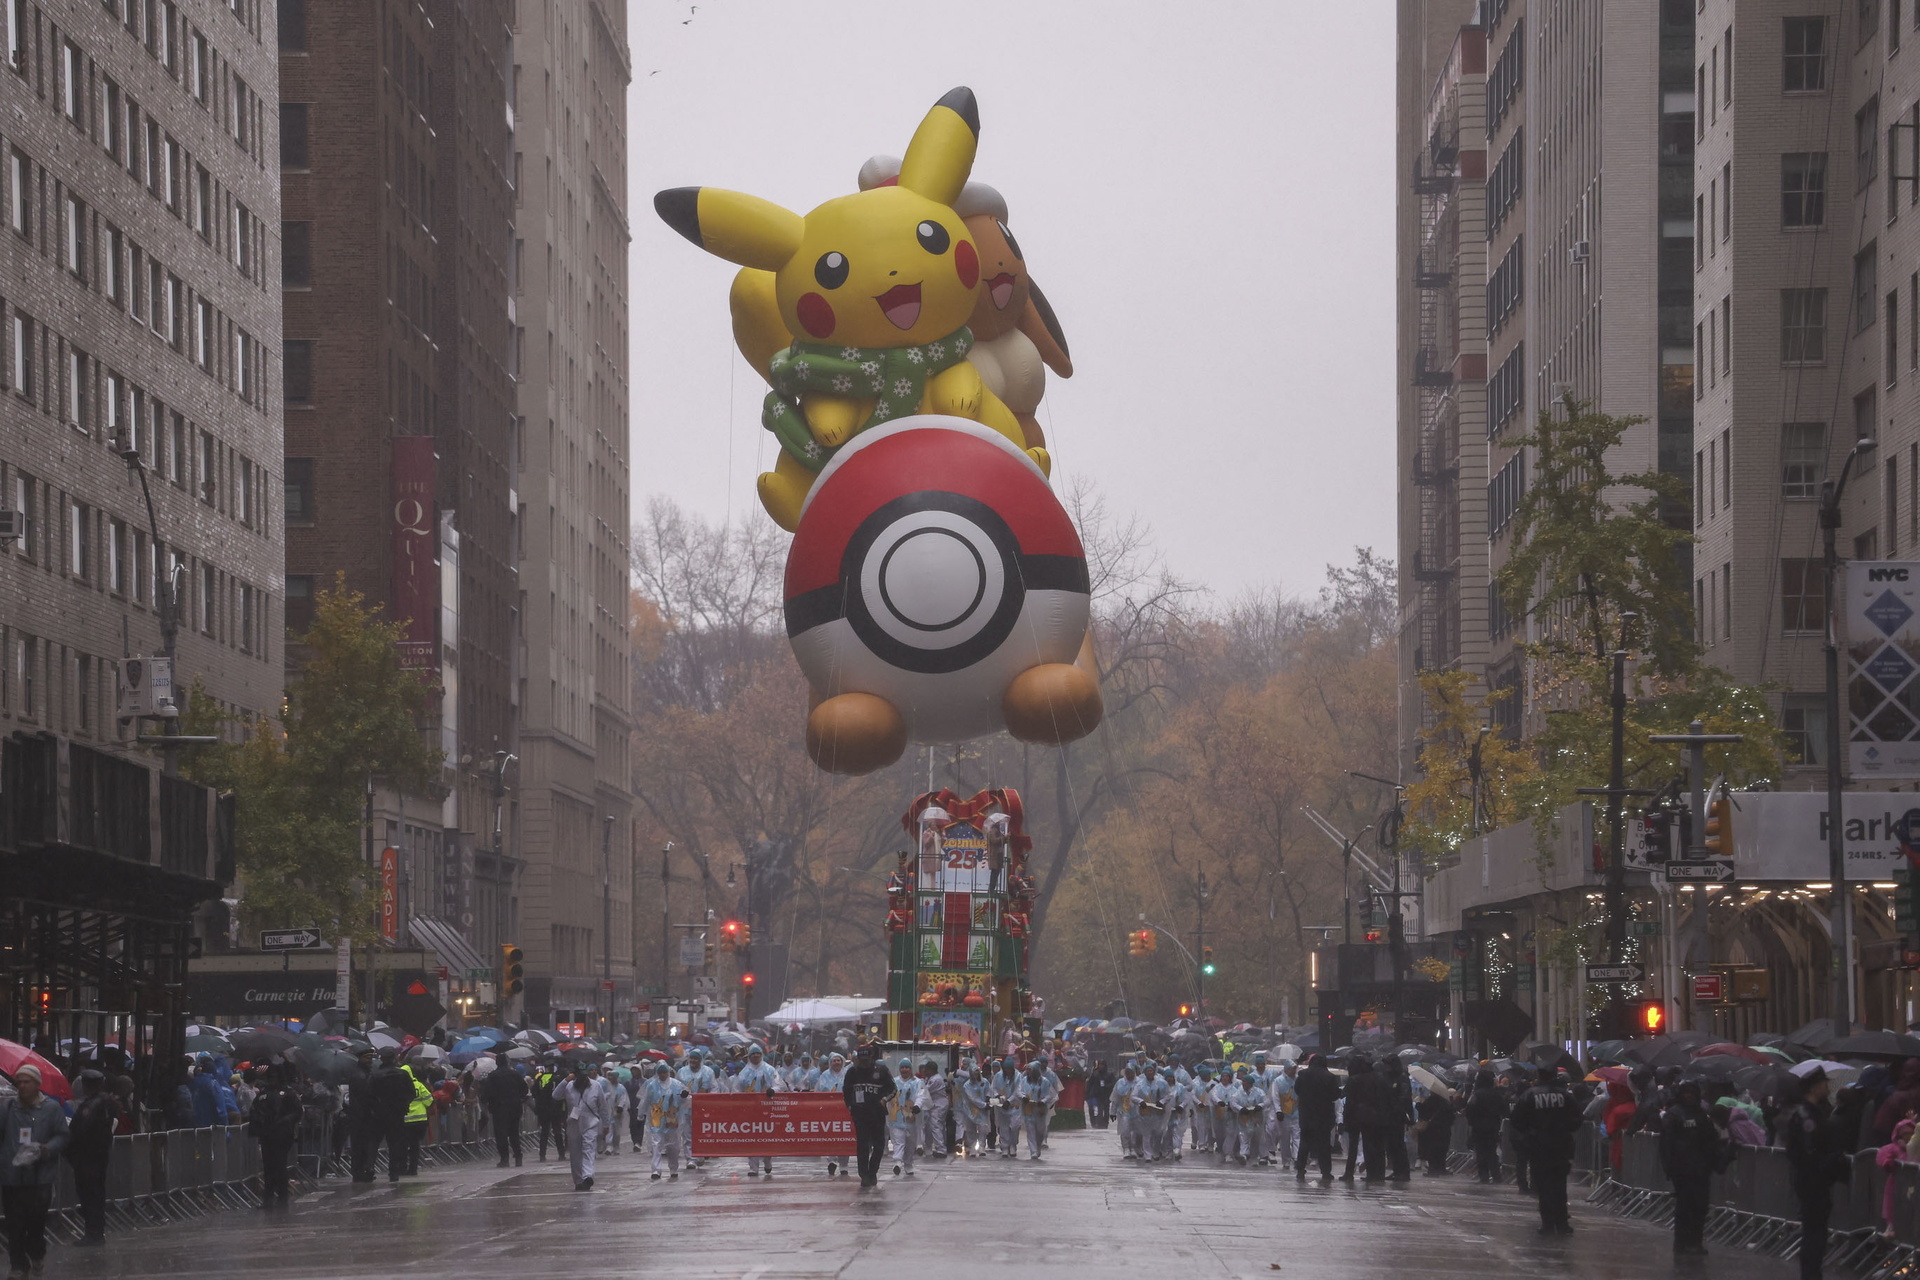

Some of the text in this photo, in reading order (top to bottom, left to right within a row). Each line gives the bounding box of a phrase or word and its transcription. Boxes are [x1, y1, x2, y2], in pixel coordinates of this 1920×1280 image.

[1868, 568, 1909, 582] NYC
[948, 849, 978, 869] 25
[1847, 851, 1886, 860] 24 HRS.
[1671, 867, 1725, 876] ONE WAY
[293, 935, 311, 943] WAY
[1593, 968, 1637, 977] ONE WAY
[244, 988, 306, 1004] Carnegie
[1534, 1092, 1565, 1109] NYPD
[702, 1121, 852, 1134] PIKACHU & EEVEE
